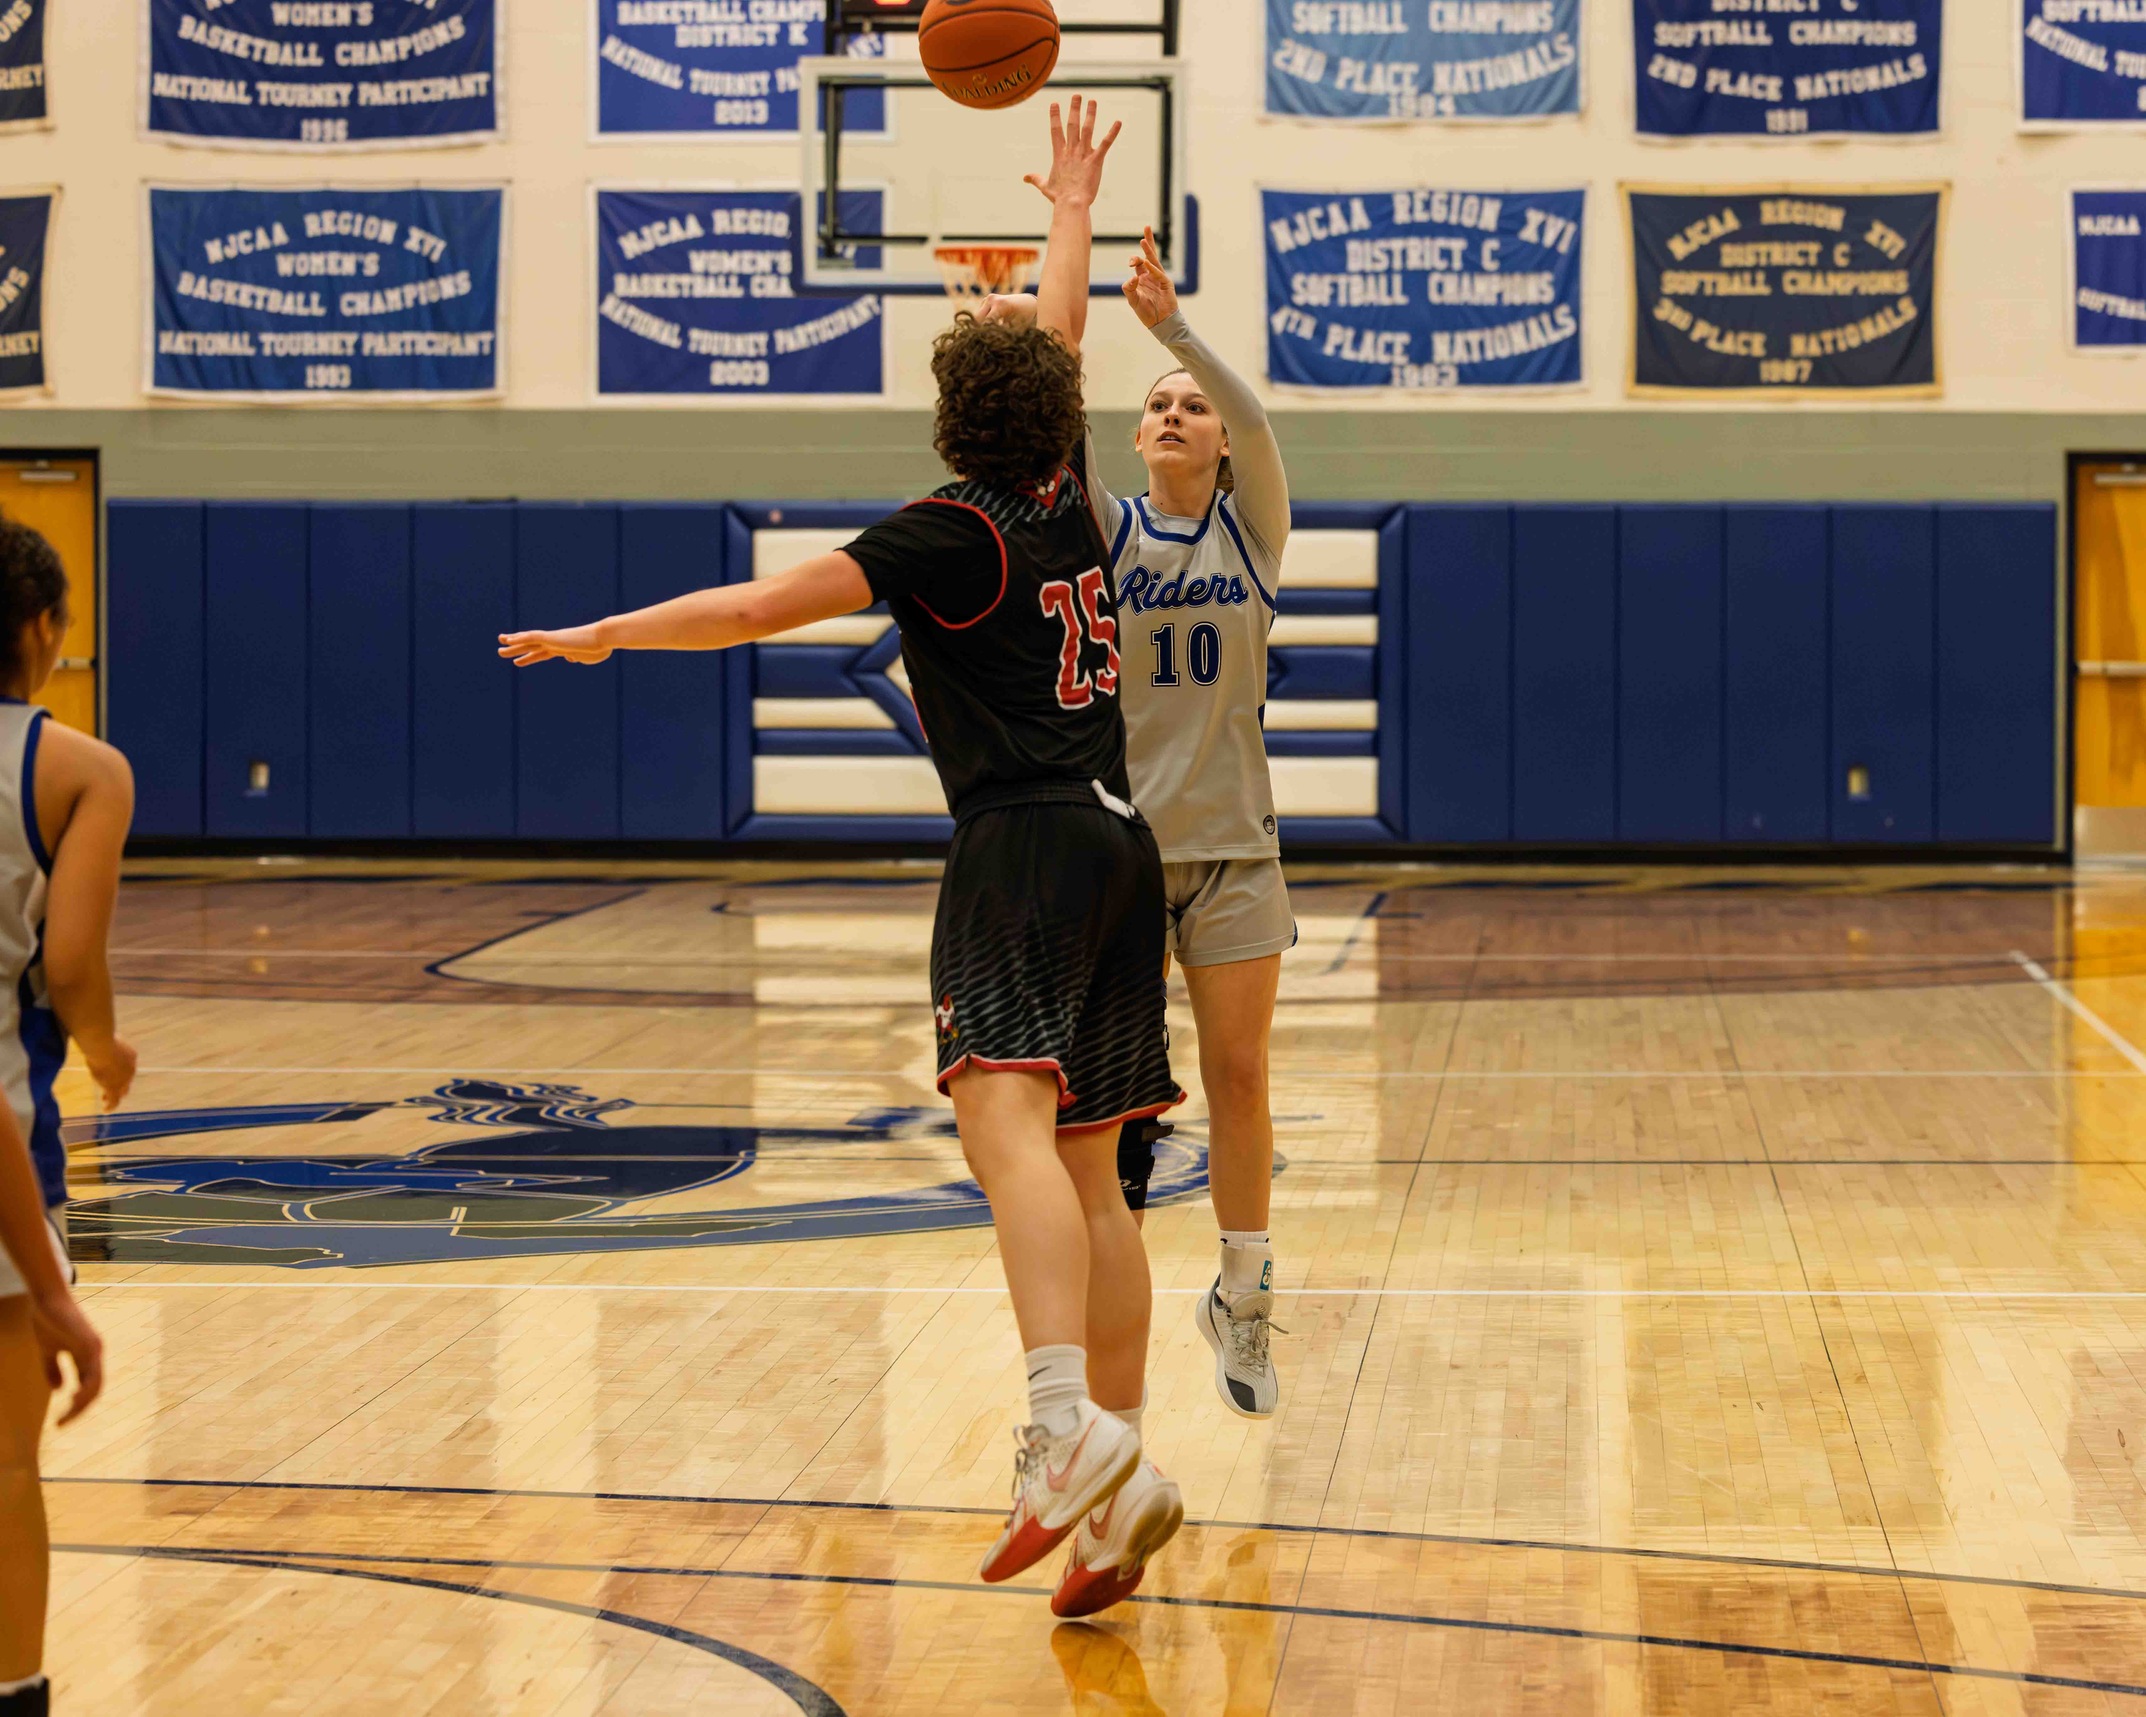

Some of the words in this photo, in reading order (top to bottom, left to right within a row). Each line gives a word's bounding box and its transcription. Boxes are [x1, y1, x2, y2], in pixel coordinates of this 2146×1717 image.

[271, 2, 374, 26] WOMEN'S
[674, 22, 780, 47] DISTRICT
[1292, 1, 1408, 34] SOFTBALL
[1429, 1, 1553, 34] CHAMPIONS
[1654, 20, 1773, 47] SOFTBALL
[1789, 20, 1917, 46] CHAMPIONS
[178, 14, 324, 66] BASKETBALL
[335, 14, 465, 66] CHAMPIONS
[1273, 38, 1327, 84] 2ND
[1335, 57, 1419, 95] PLACE
[1433, 32, 1575, 94] NATIONALS
[2024, 15, 2108, 72] NATIONAL
[153, 72, 252, 105] NATIONAL
[256, 81, 353, 107] TOURNEY
[357, 72, 491, 106] PARTICIPANT
[600, 34, 684, 90] NATIONAL
[690, 68, 770, 97] TOURNEY
[1648, 53, 1697, 89] 2ND
[1705, 67, 1783, 102] PLACE
[1793, 53, 1927, 101] NATIONALS
[205, 222, 289, 264] NJCAA
[304, 210, 397, 245] REGION
[403, 225, 447, 263] XVI
[617, 213, 705, 260] NJCAA
[712, 208, 791, 239] REGIO
[1269, 197, 1371, 253] NJCAA
[1392, 191, 1502, 232] REGION
[1518, 208, 1577, 254] XVI
[1666, 206, 1741, 262] NJCAA
[1760, 200, 1846, 232] REGION
[1863, 219, 1907, 260] XVI
[2078, 214, 2141, 236] NJCAA
[276, 251, 380, 277] WOMEN'S
[688, 250, 792, 275] WOMEN'S
[1346, 236, 1468, 272] DISTRICT
[1481, 239, 1500, 272] C
[1720, 241, 1822, 268] DISTRICT
[1833, 242, 1850, 268] C
[177, 271, 327, 317] BASKETBALL
[339, 270, 472, 317] CHAMPIONS
[614, 273, 744, 298] BASKETBALL
[1291, 272, 1409, 307] SOFTBALL
[1427, 271, 1556, 306] CHAMPIONS
[1661, 270, 1772, 296] SOFTBALL
[1782, 269, 1909, 296] CHAMPIONS
[159, 330, 256, 356] NATIONAL
[258, 331, 358, 357] TOURNEY
[362, 330, 494, 357] PARTICIPANT
[600, 293, 682, 349] NATIONAL
[688, 327, 769, 357] TOURNEY
[774, 294, 881, 354] PARTICIPANT
[1270, 305, 1317, 341] 4TH
[1323, 323, 1411, 365] PLACE
[1431, 303, 1577, 364] NATIONALS
[1689, 319, 1767, 357] PLACE
[1790, 296, 1918, 357] NATIONALS
[1117, 564, 1249, 616] Riders
[1039, 565, 1120, 710] 25
[1150, 620, 1222, 687] 10
